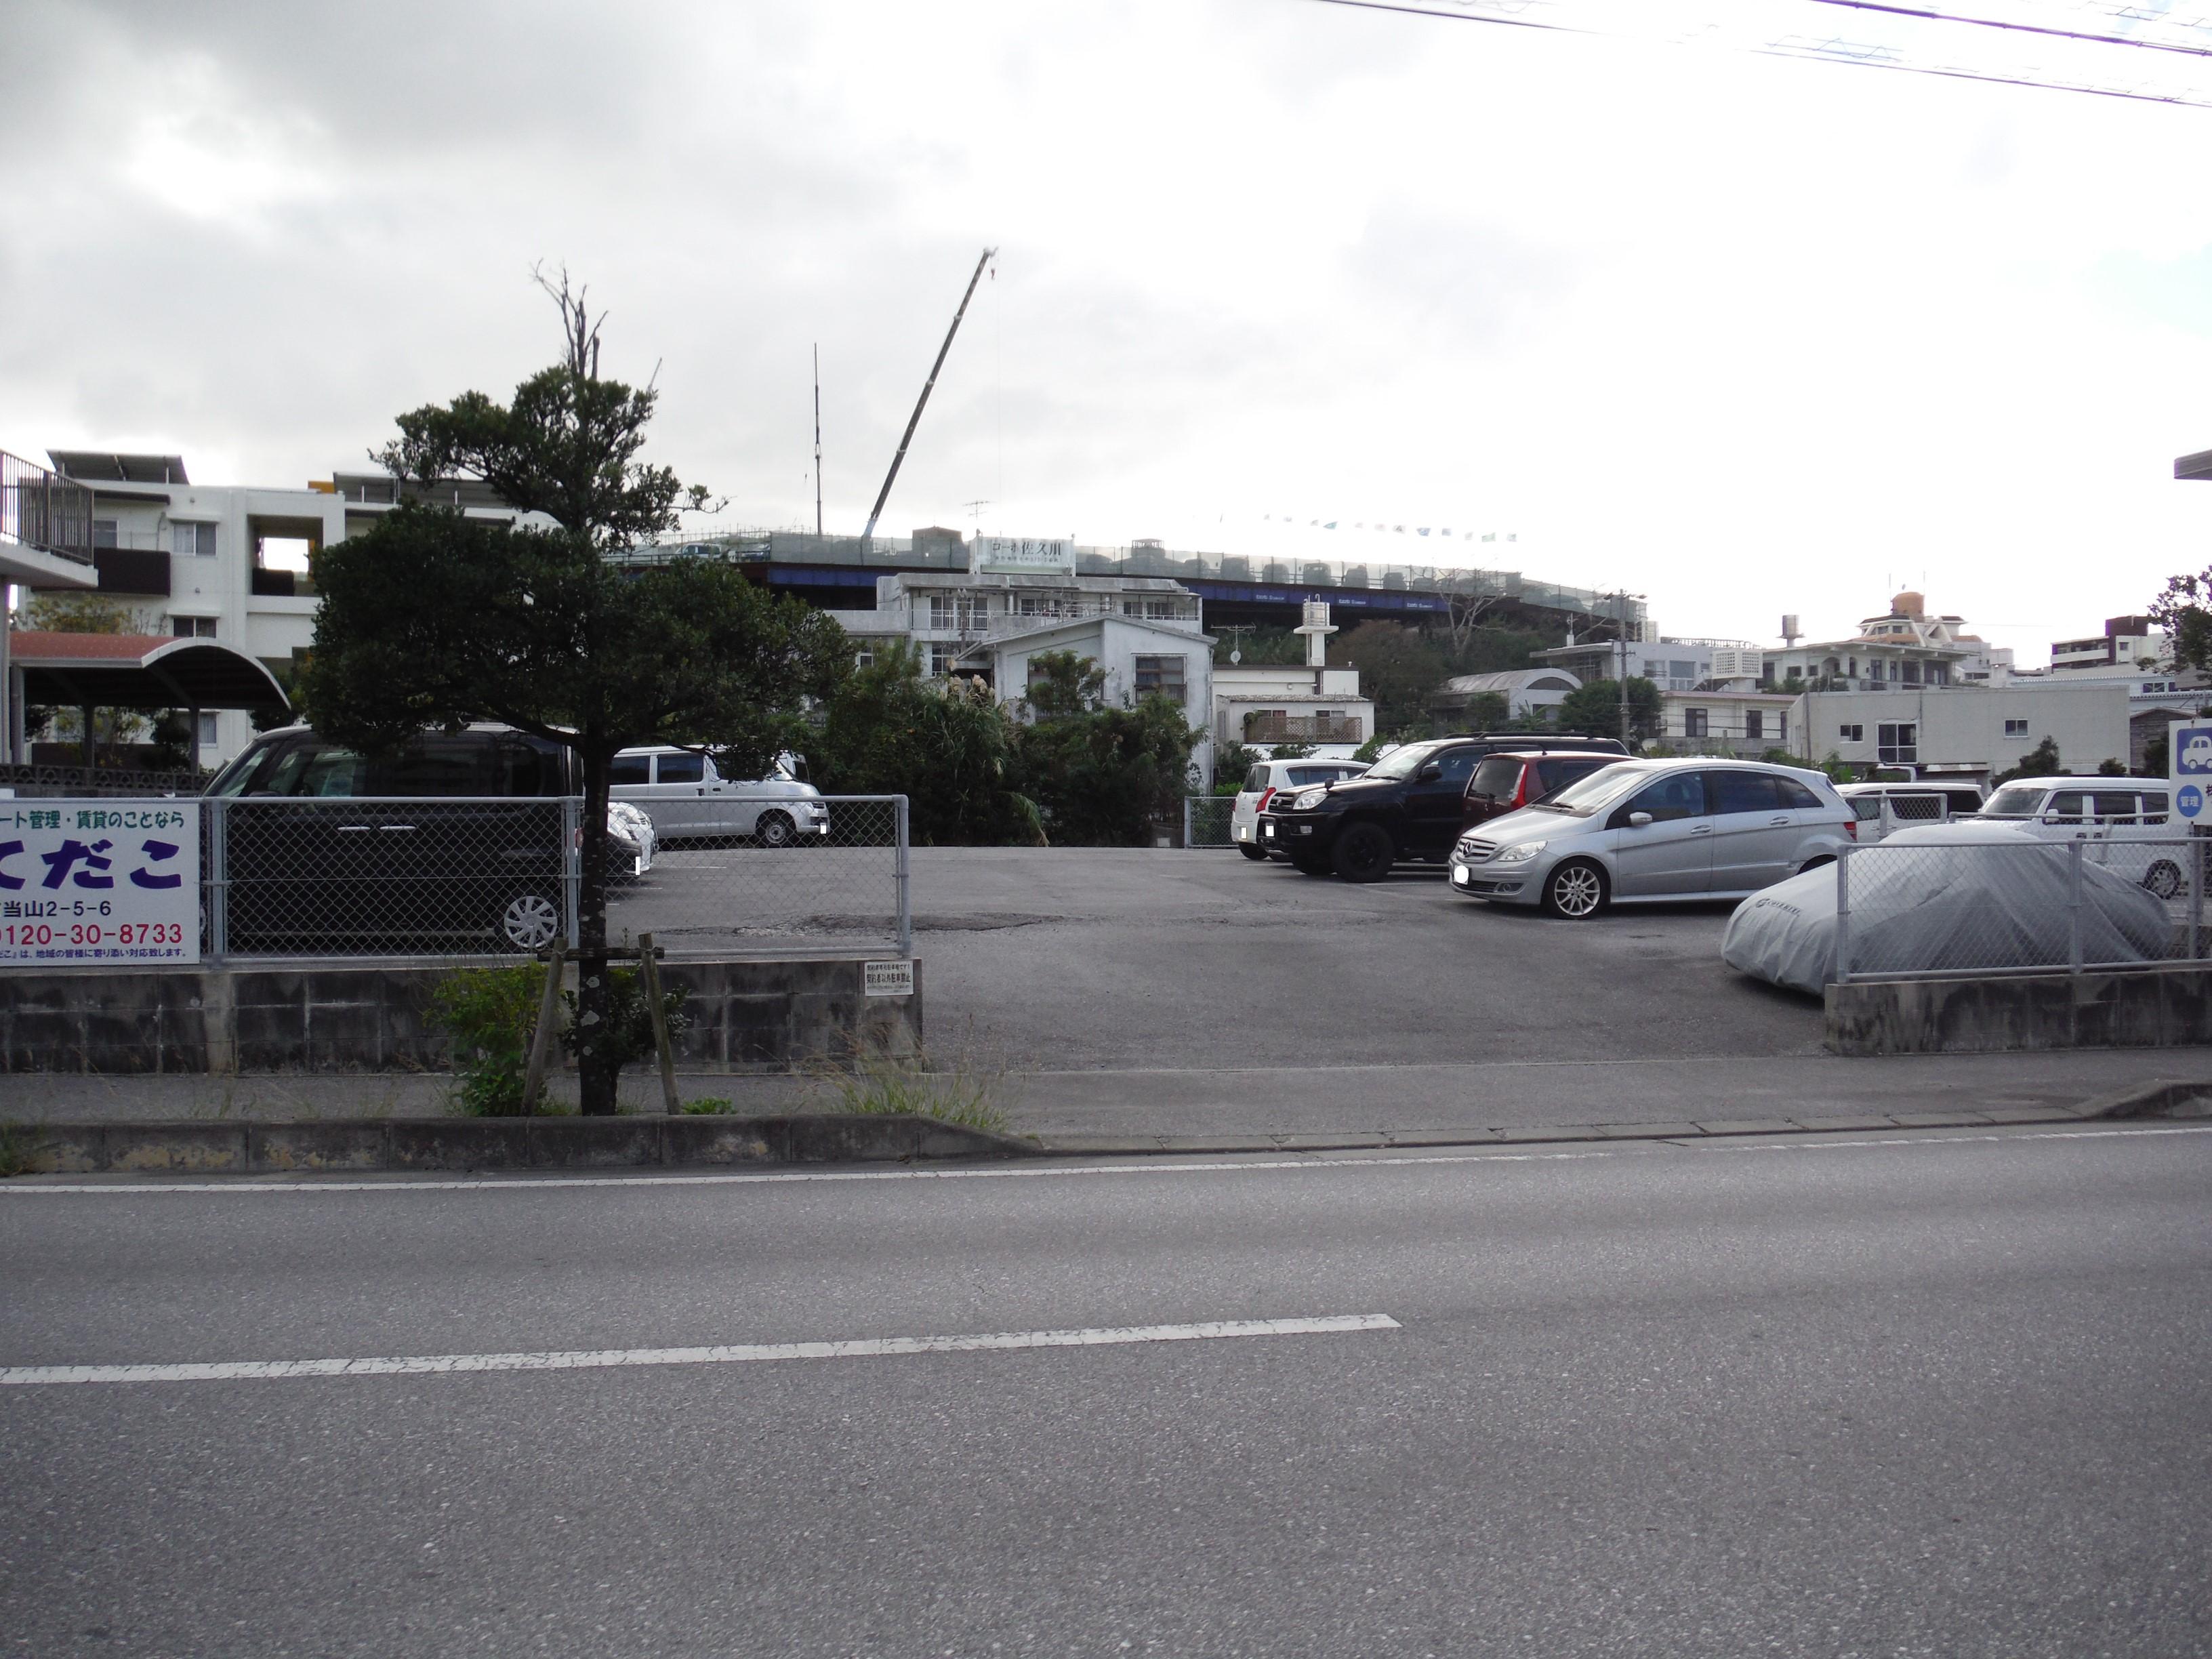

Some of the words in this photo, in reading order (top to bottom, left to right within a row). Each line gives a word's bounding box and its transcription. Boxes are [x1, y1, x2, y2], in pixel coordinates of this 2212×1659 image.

[2180, 796, 2199, 806] 管理
[0, 900, 112, 918] 当山2-5-6
[0, 924, 182, 945] 120-30-8733
